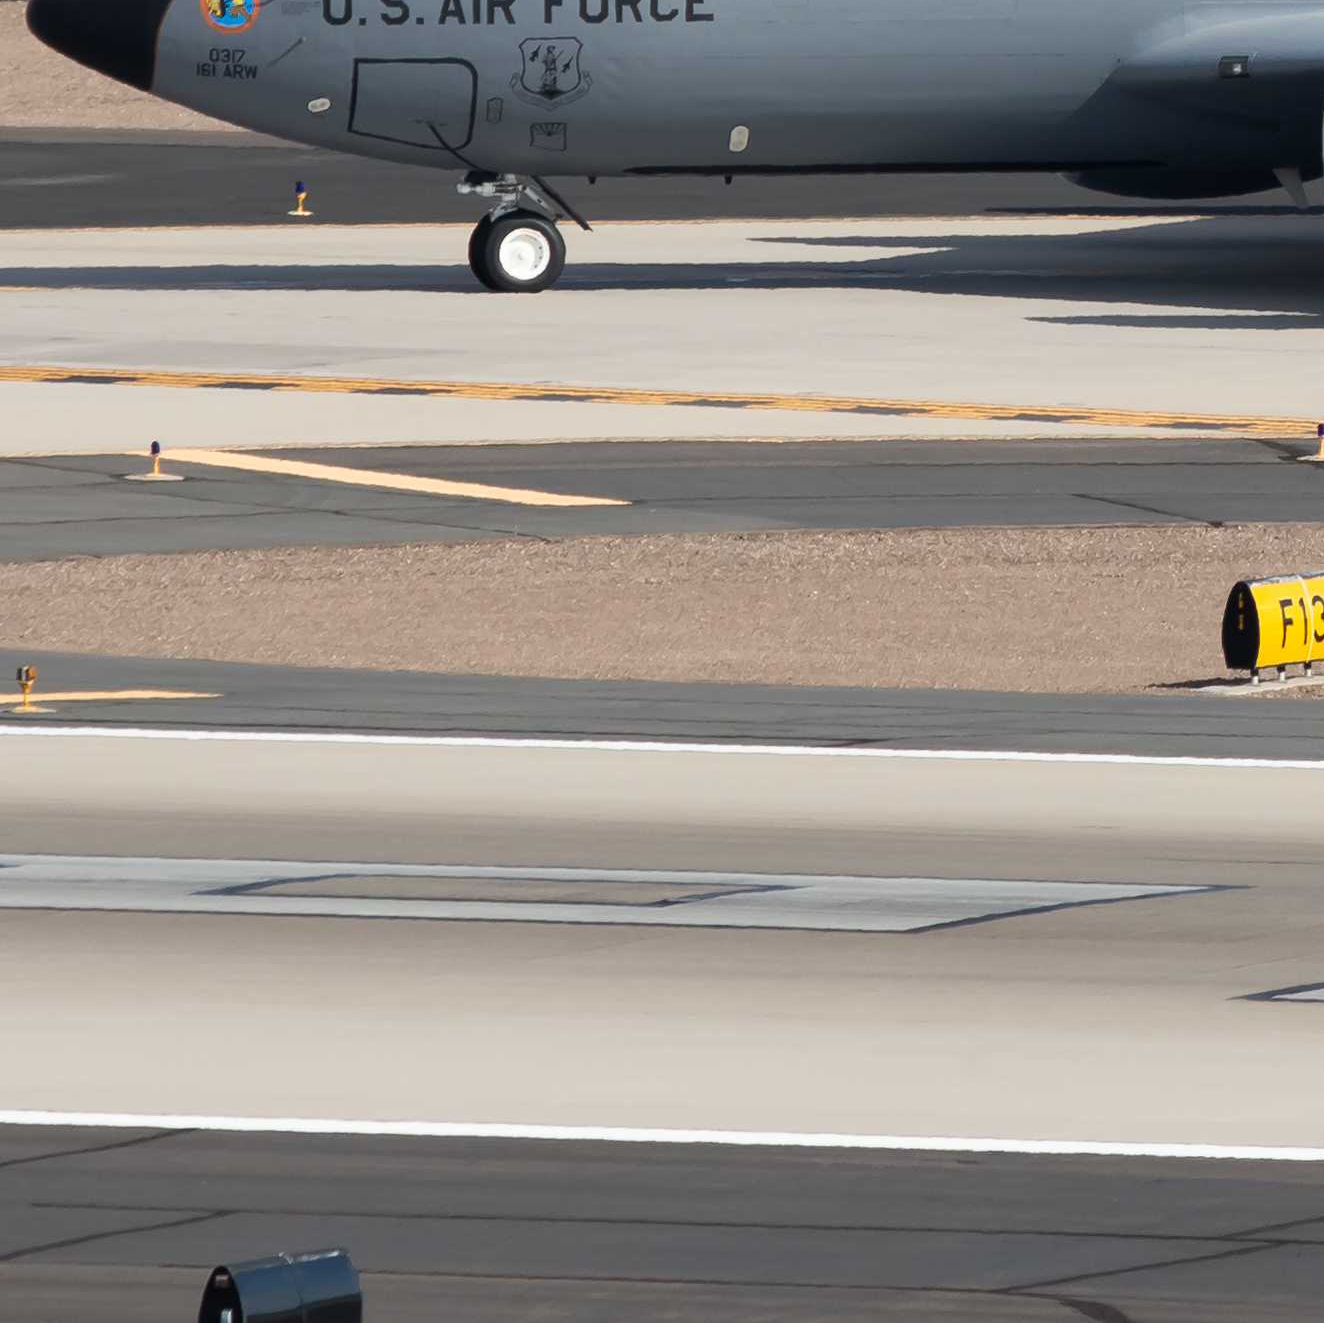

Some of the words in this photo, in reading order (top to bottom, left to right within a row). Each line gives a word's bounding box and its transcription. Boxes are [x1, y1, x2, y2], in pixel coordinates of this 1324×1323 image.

[208, 47, 246, 64] 0317
[196, 62, 216, 77] 161
[223, 64, 258, 79] ARW
